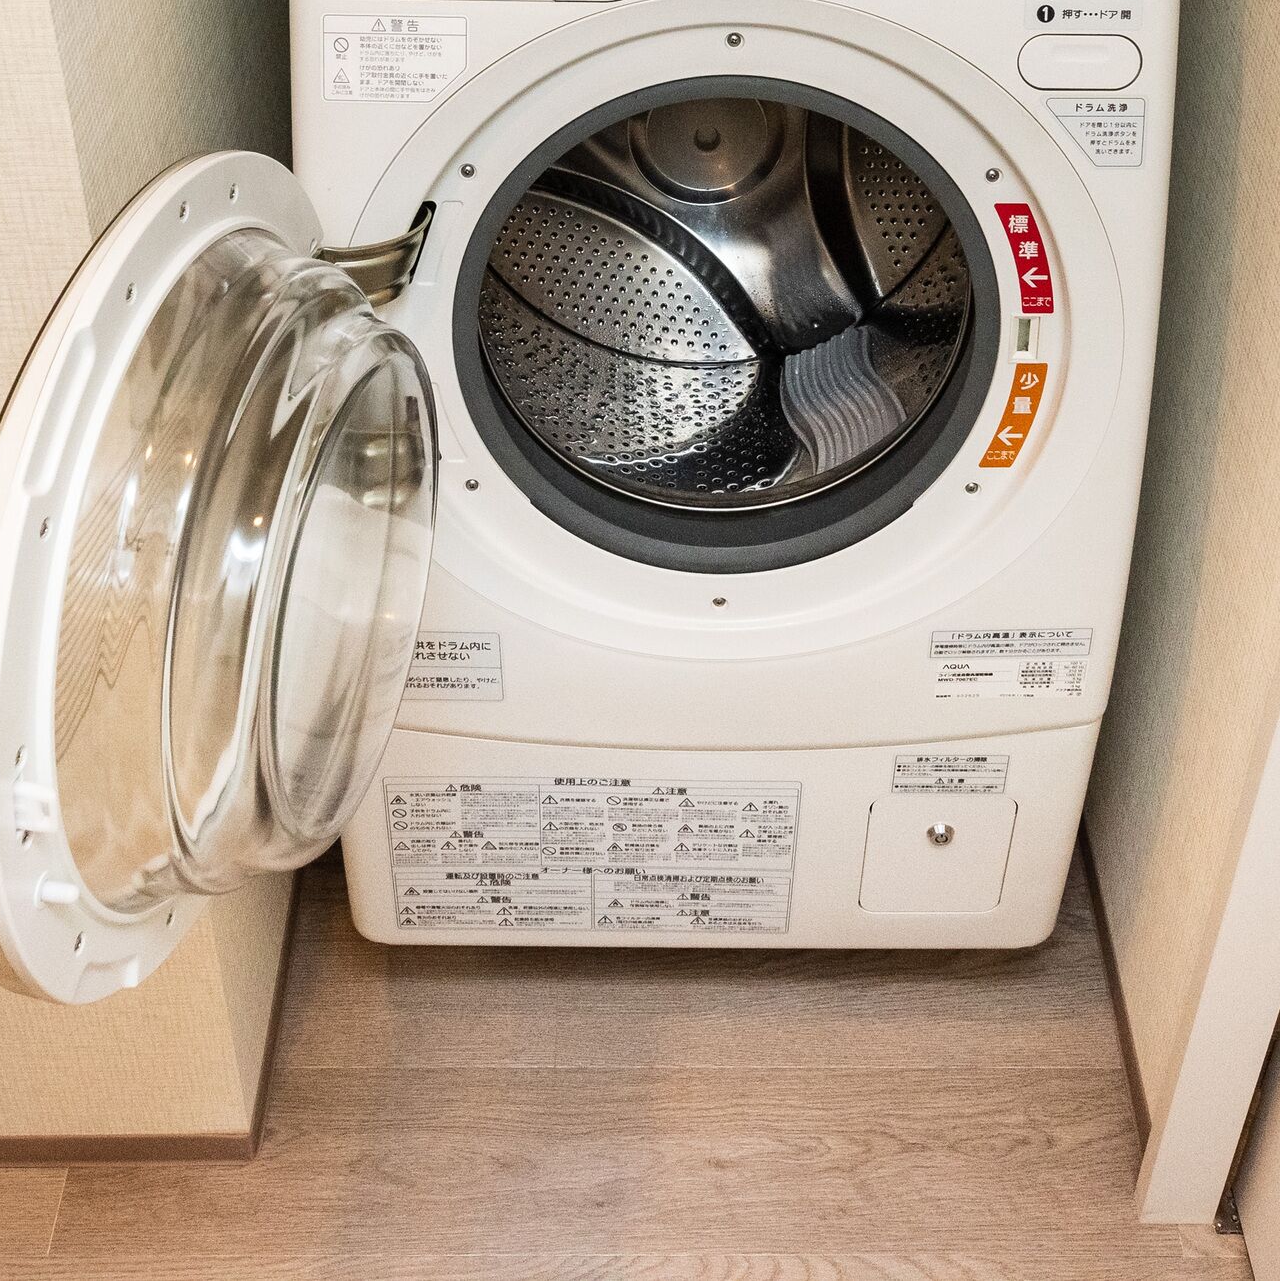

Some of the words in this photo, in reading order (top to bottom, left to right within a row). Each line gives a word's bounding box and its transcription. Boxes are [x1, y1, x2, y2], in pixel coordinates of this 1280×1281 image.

[390, 19, 420, 32] 警告
[1075, 103, 1128, 112] ドラム洗浄
[1008, 214, 1039, 260] 標準
[1022, 296, 1052, 307] ここまで
[1012, 371, 1039, 414] 少量
[987, 450, 1016, 461] ここまで
[412, 651, 470, 661] れさせない
[554, 777, 632, 787] 使用上のご注意
[459, 783, 483, 792] 危険
[665, 787, 688, 796] 注意
